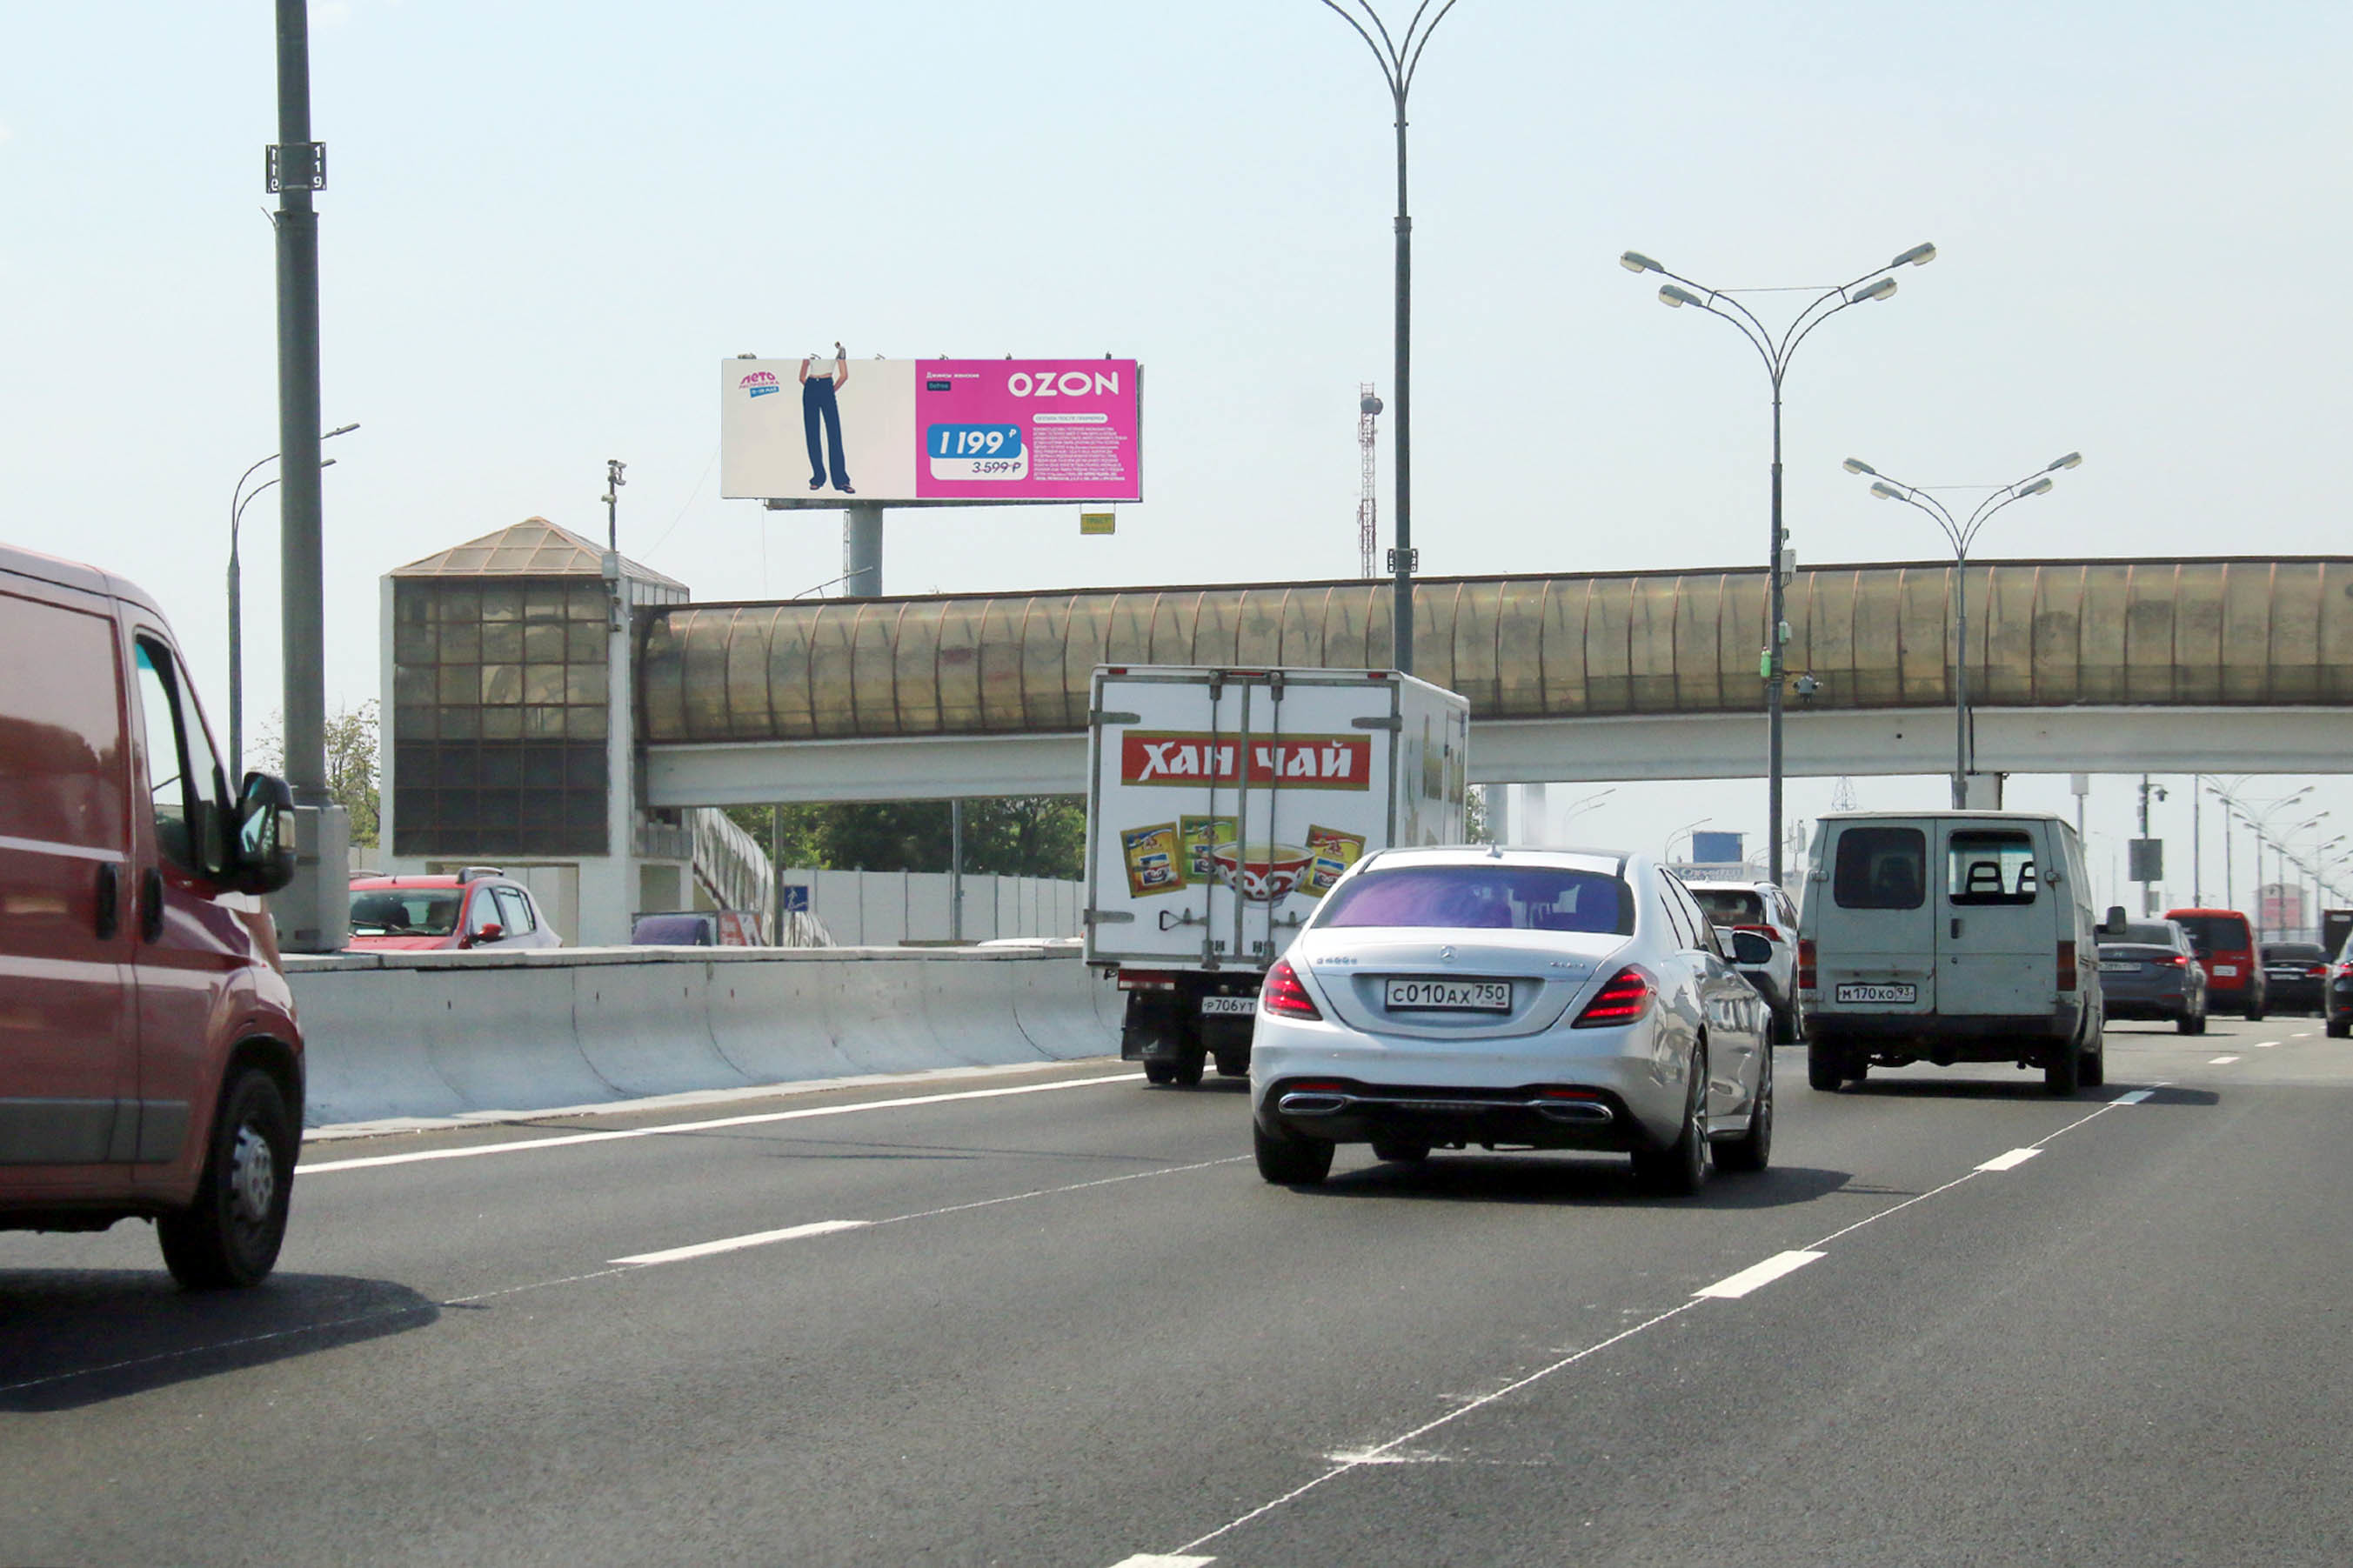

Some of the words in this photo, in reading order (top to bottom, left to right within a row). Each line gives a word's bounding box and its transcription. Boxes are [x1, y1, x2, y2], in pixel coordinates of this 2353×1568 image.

[313, 145, 323, 189] 119
[1007, 371, 1119, 397] OZON
[1138, 741, 1234, 782] ХАН
[1254, 739, 1353, 778] ЧАЙ
[1393, 984, 1471, 1004] С010АХ
[1475, 984, 1506, 1000] 750
[1842, 987, 1895, 999] М170КО
[1896, 987, 1910, 996] 93
[1206, 998, 1255, 1012] Р706УТ
